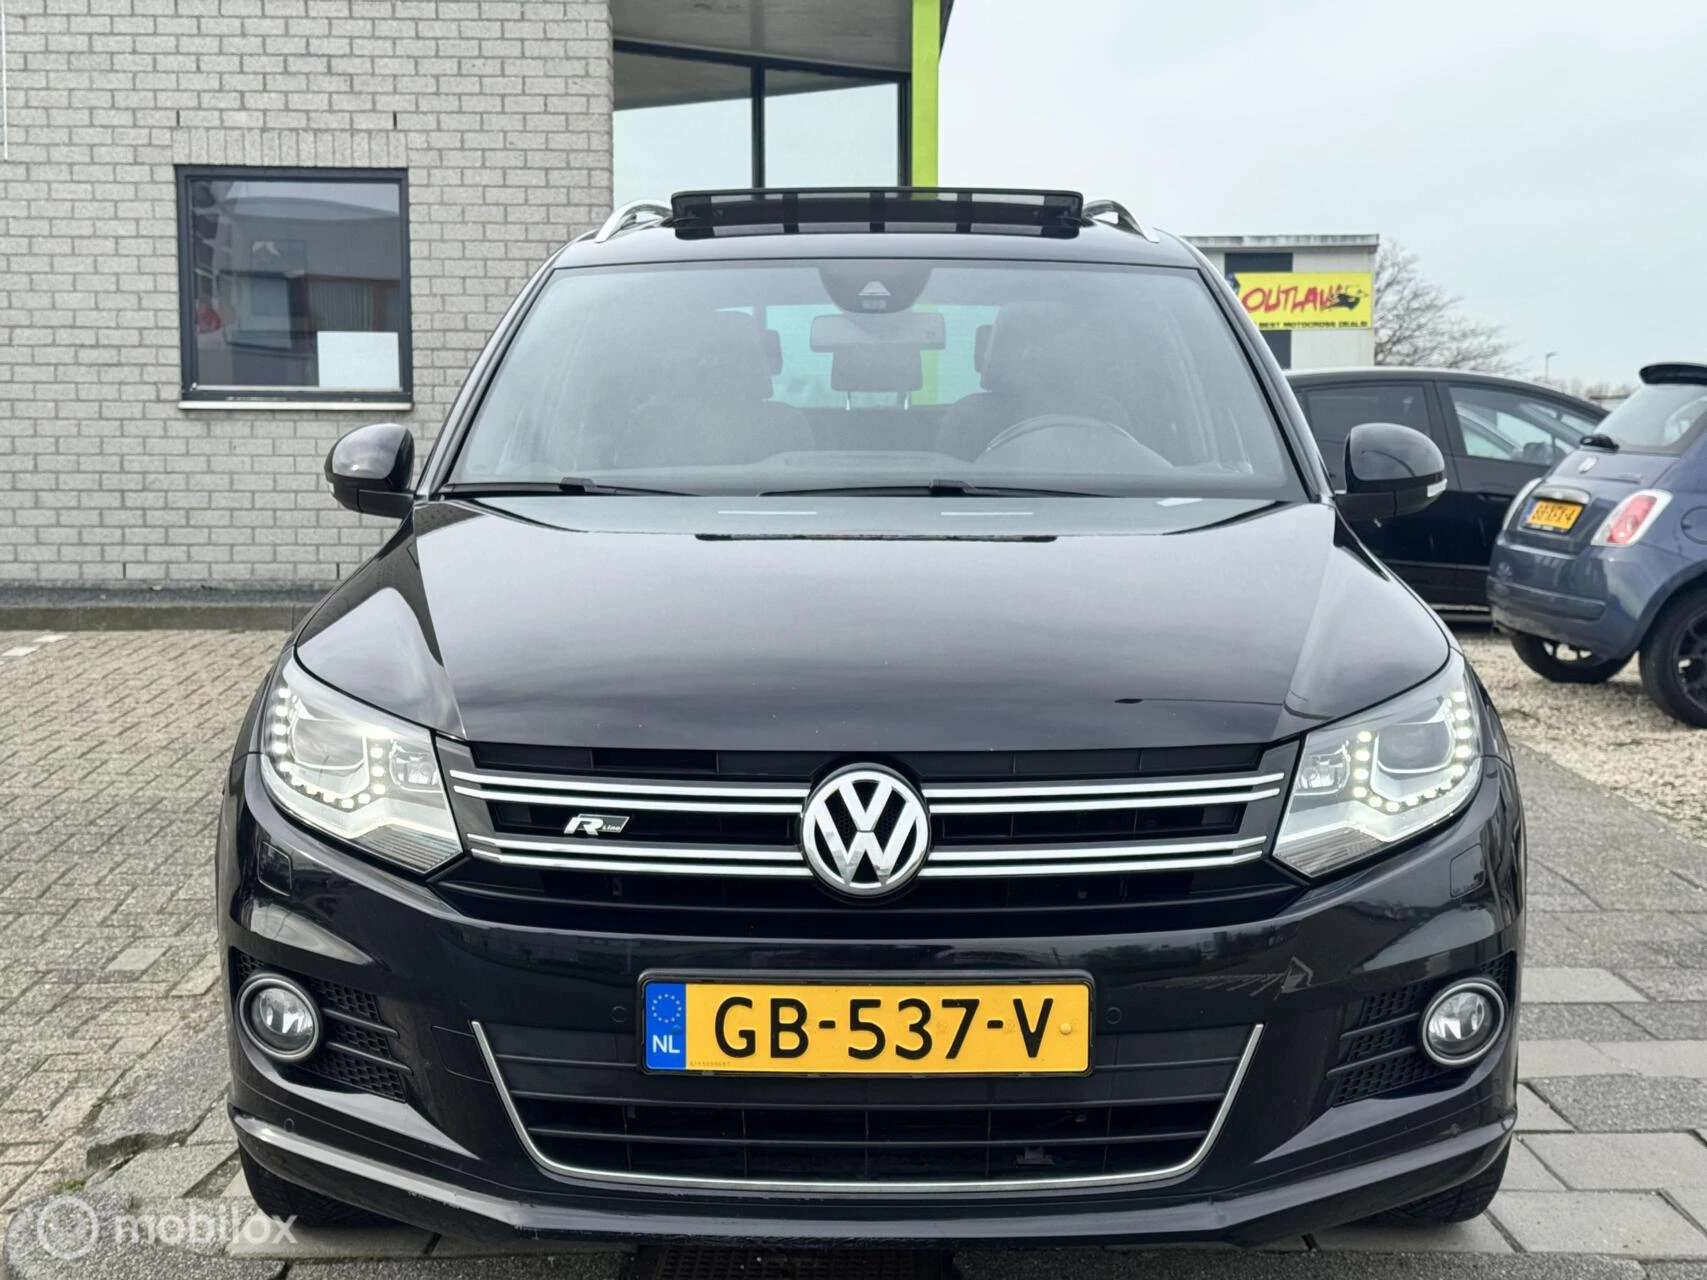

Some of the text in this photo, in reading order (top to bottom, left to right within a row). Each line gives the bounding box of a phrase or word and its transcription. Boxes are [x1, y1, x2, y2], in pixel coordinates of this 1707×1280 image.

[1242, 284, 1343, 313] OUTLAW
[714, 996, 1054, 1060] GB-537-V
[652, 1034, 681, 1054] NL
